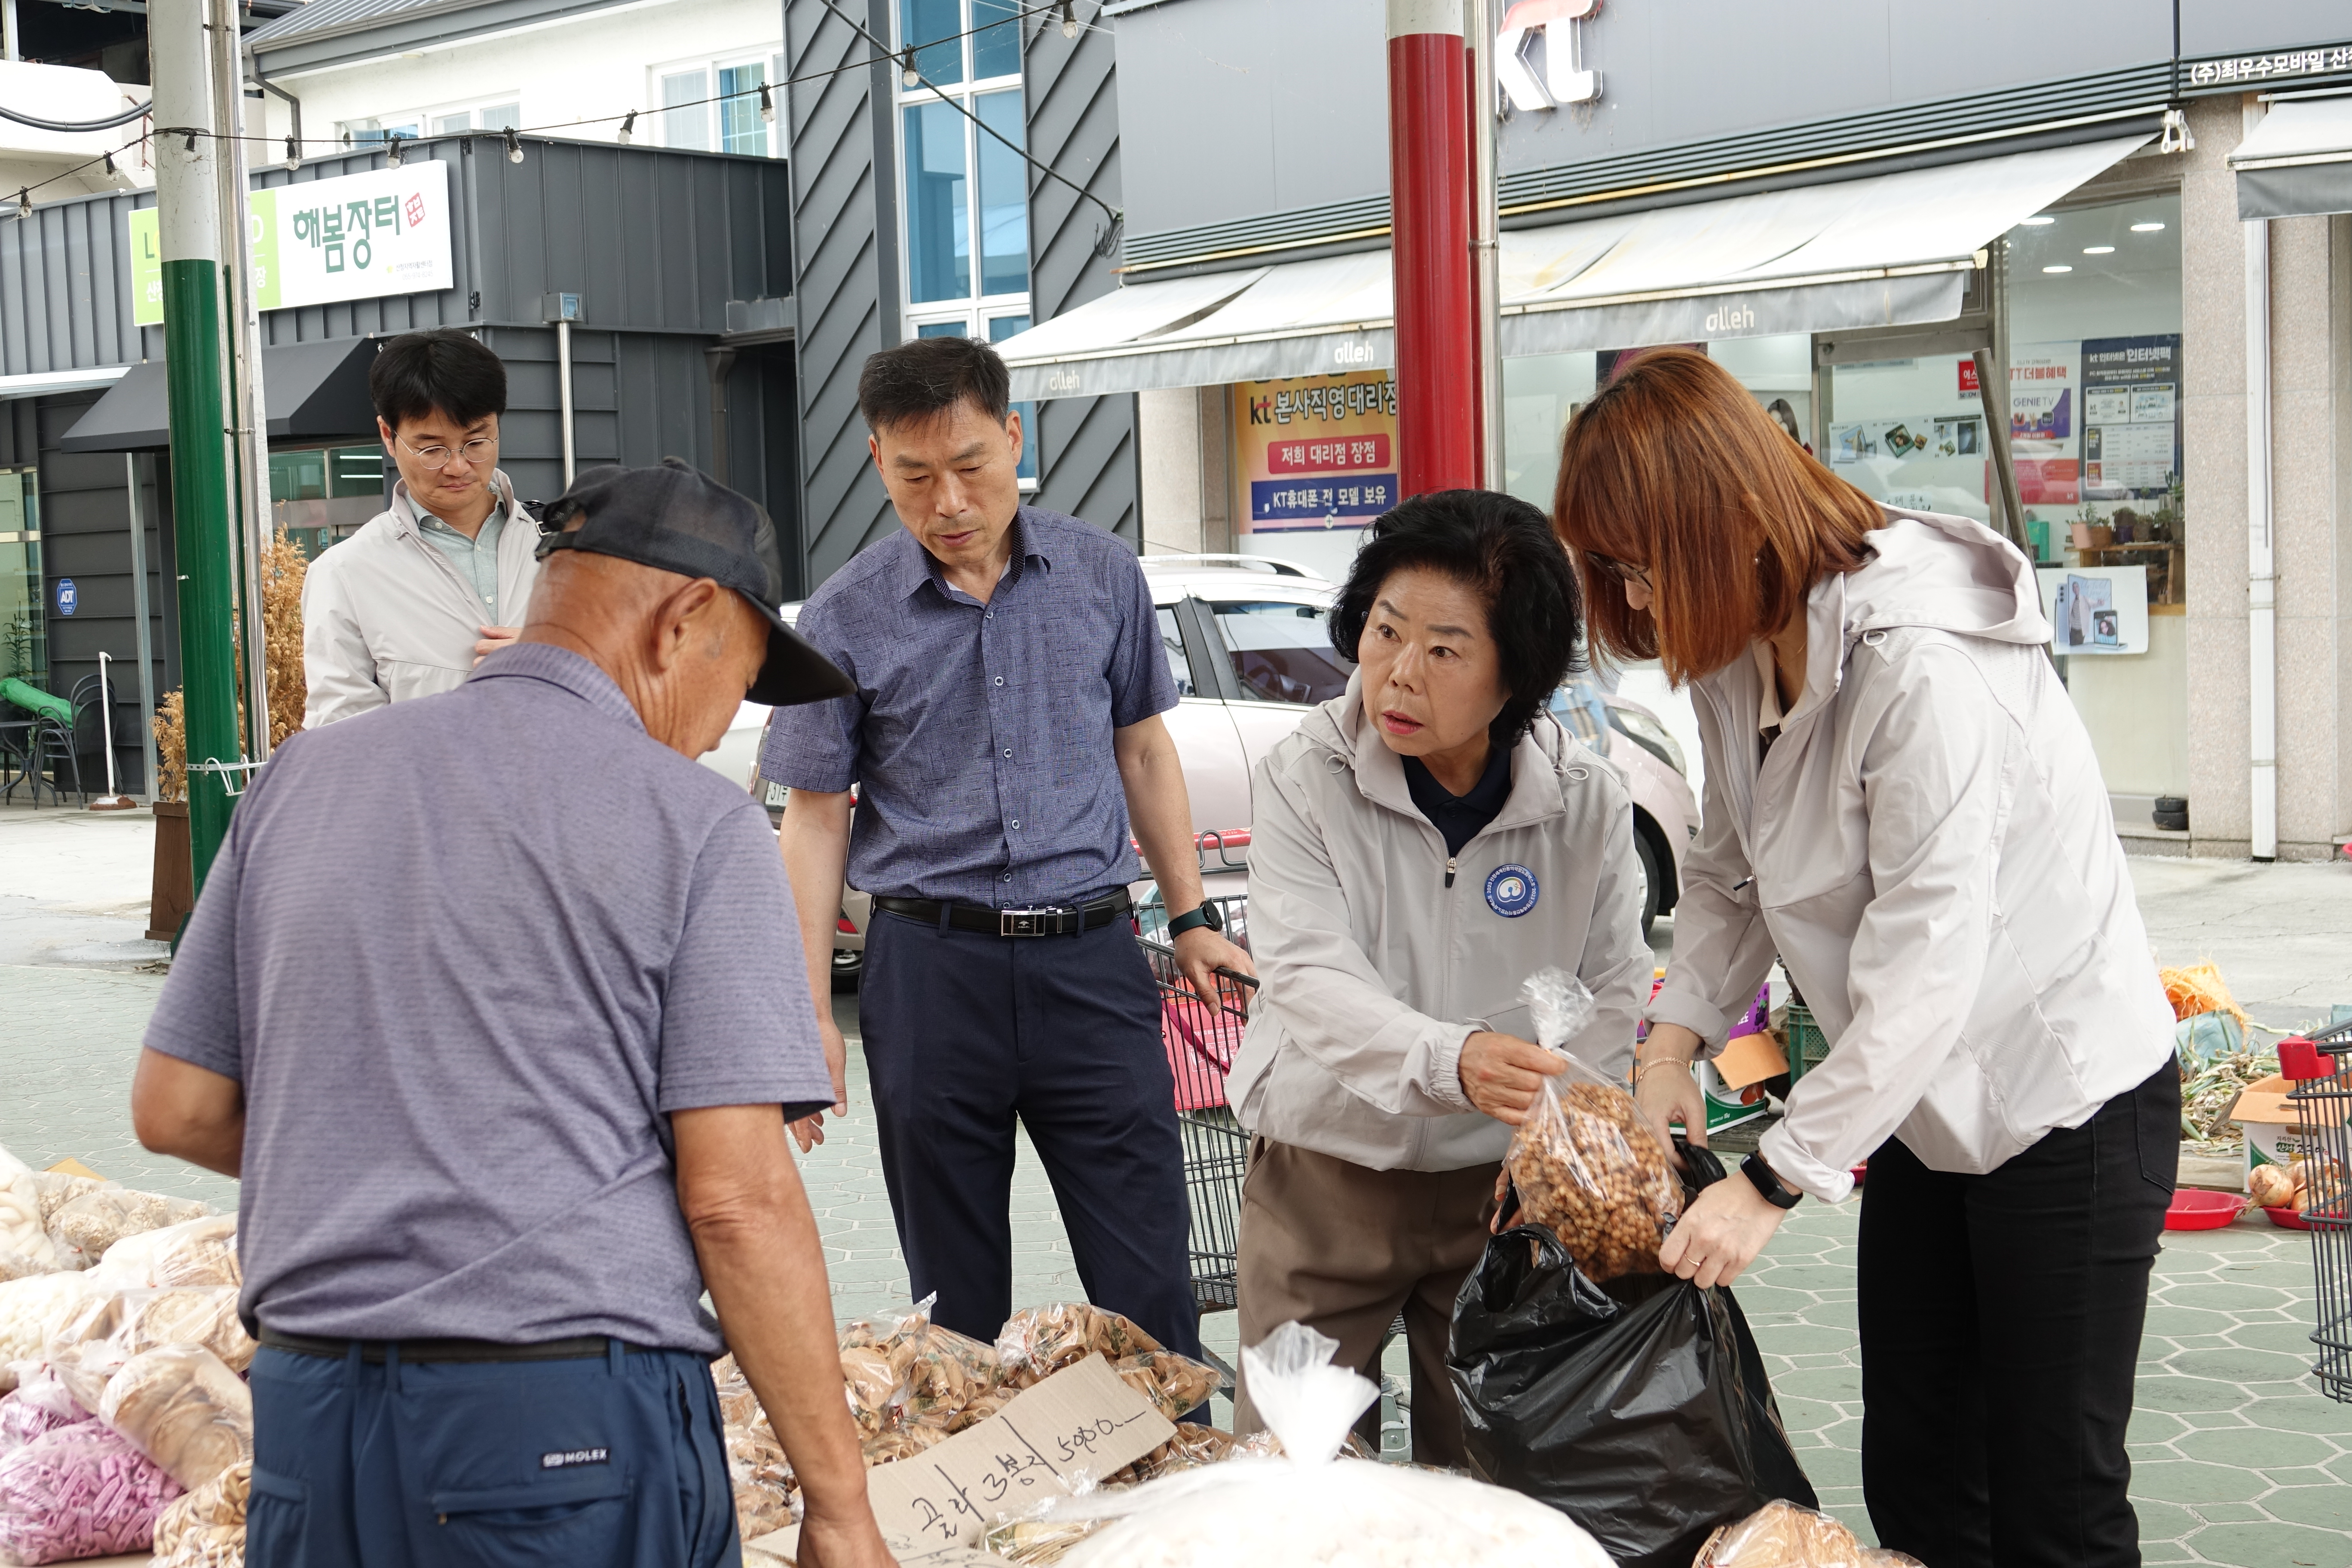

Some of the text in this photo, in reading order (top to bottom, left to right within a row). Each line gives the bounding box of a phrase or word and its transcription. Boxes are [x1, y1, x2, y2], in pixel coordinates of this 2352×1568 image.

[2191, 49, 2325, 84] (주)최우수모바일
[293, 195, 401, 273] 해봄장터
[2127, 345, 2171, 363] 인터넷팩
[1250, 395, 1272, 425] kt
[2013, 396, 2054, 408] GENIE TV
[1281, 440, 1375, 467] 저희 대리점 장점
[1273, 490, 1318, 510] KT휴대폰
[1338, 485, 1360, 507] 모델
[1364, 484, 1387, 506] 보유
[61, 590, 74, 603] ADT
[564, 1448, 607, 1464] MOLEX
